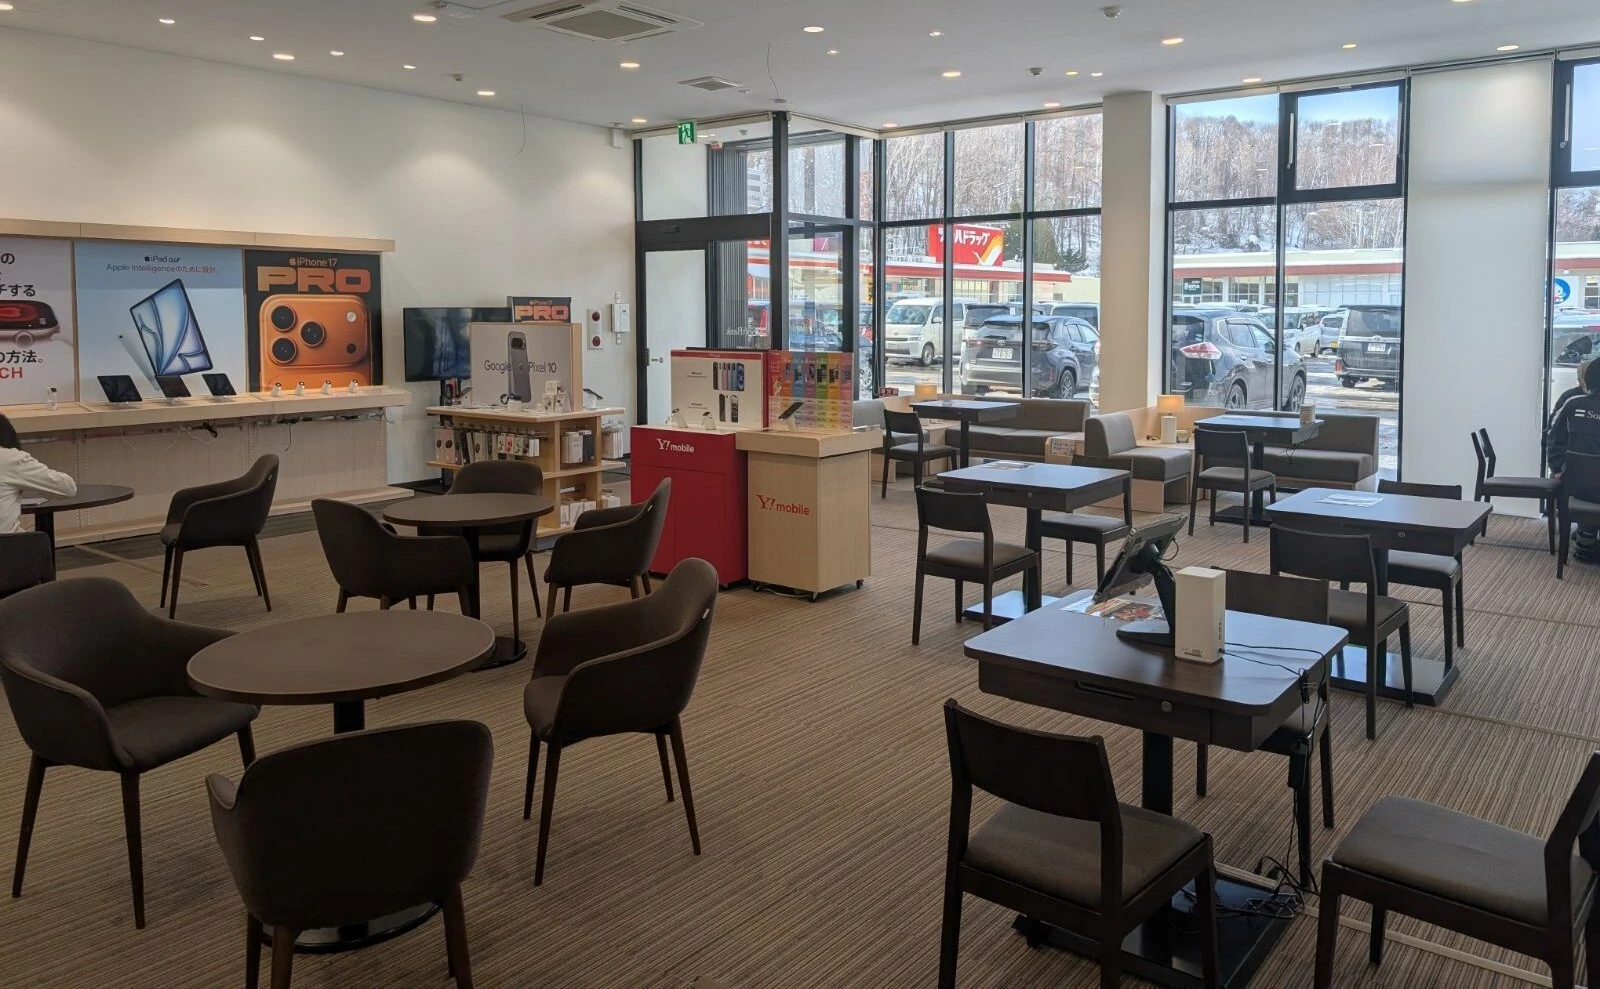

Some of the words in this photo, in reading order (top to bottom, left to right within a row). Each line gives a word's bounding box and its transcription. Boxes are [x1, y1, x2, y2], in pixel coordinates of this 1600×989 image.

[150, 255, 168, 263] iPad
[297, 257, 328, 267] iPhone
[328, 258, 338, 268] 17
[106, 263, 130, 272] Apple
[257, 266, 371, 293] PRO
[514, 305, 569, 320] PRO
[483, 359, 512, 374] Google
[528, 361, 546, 373] Pixel
[547, 362, 557, 374] 10
